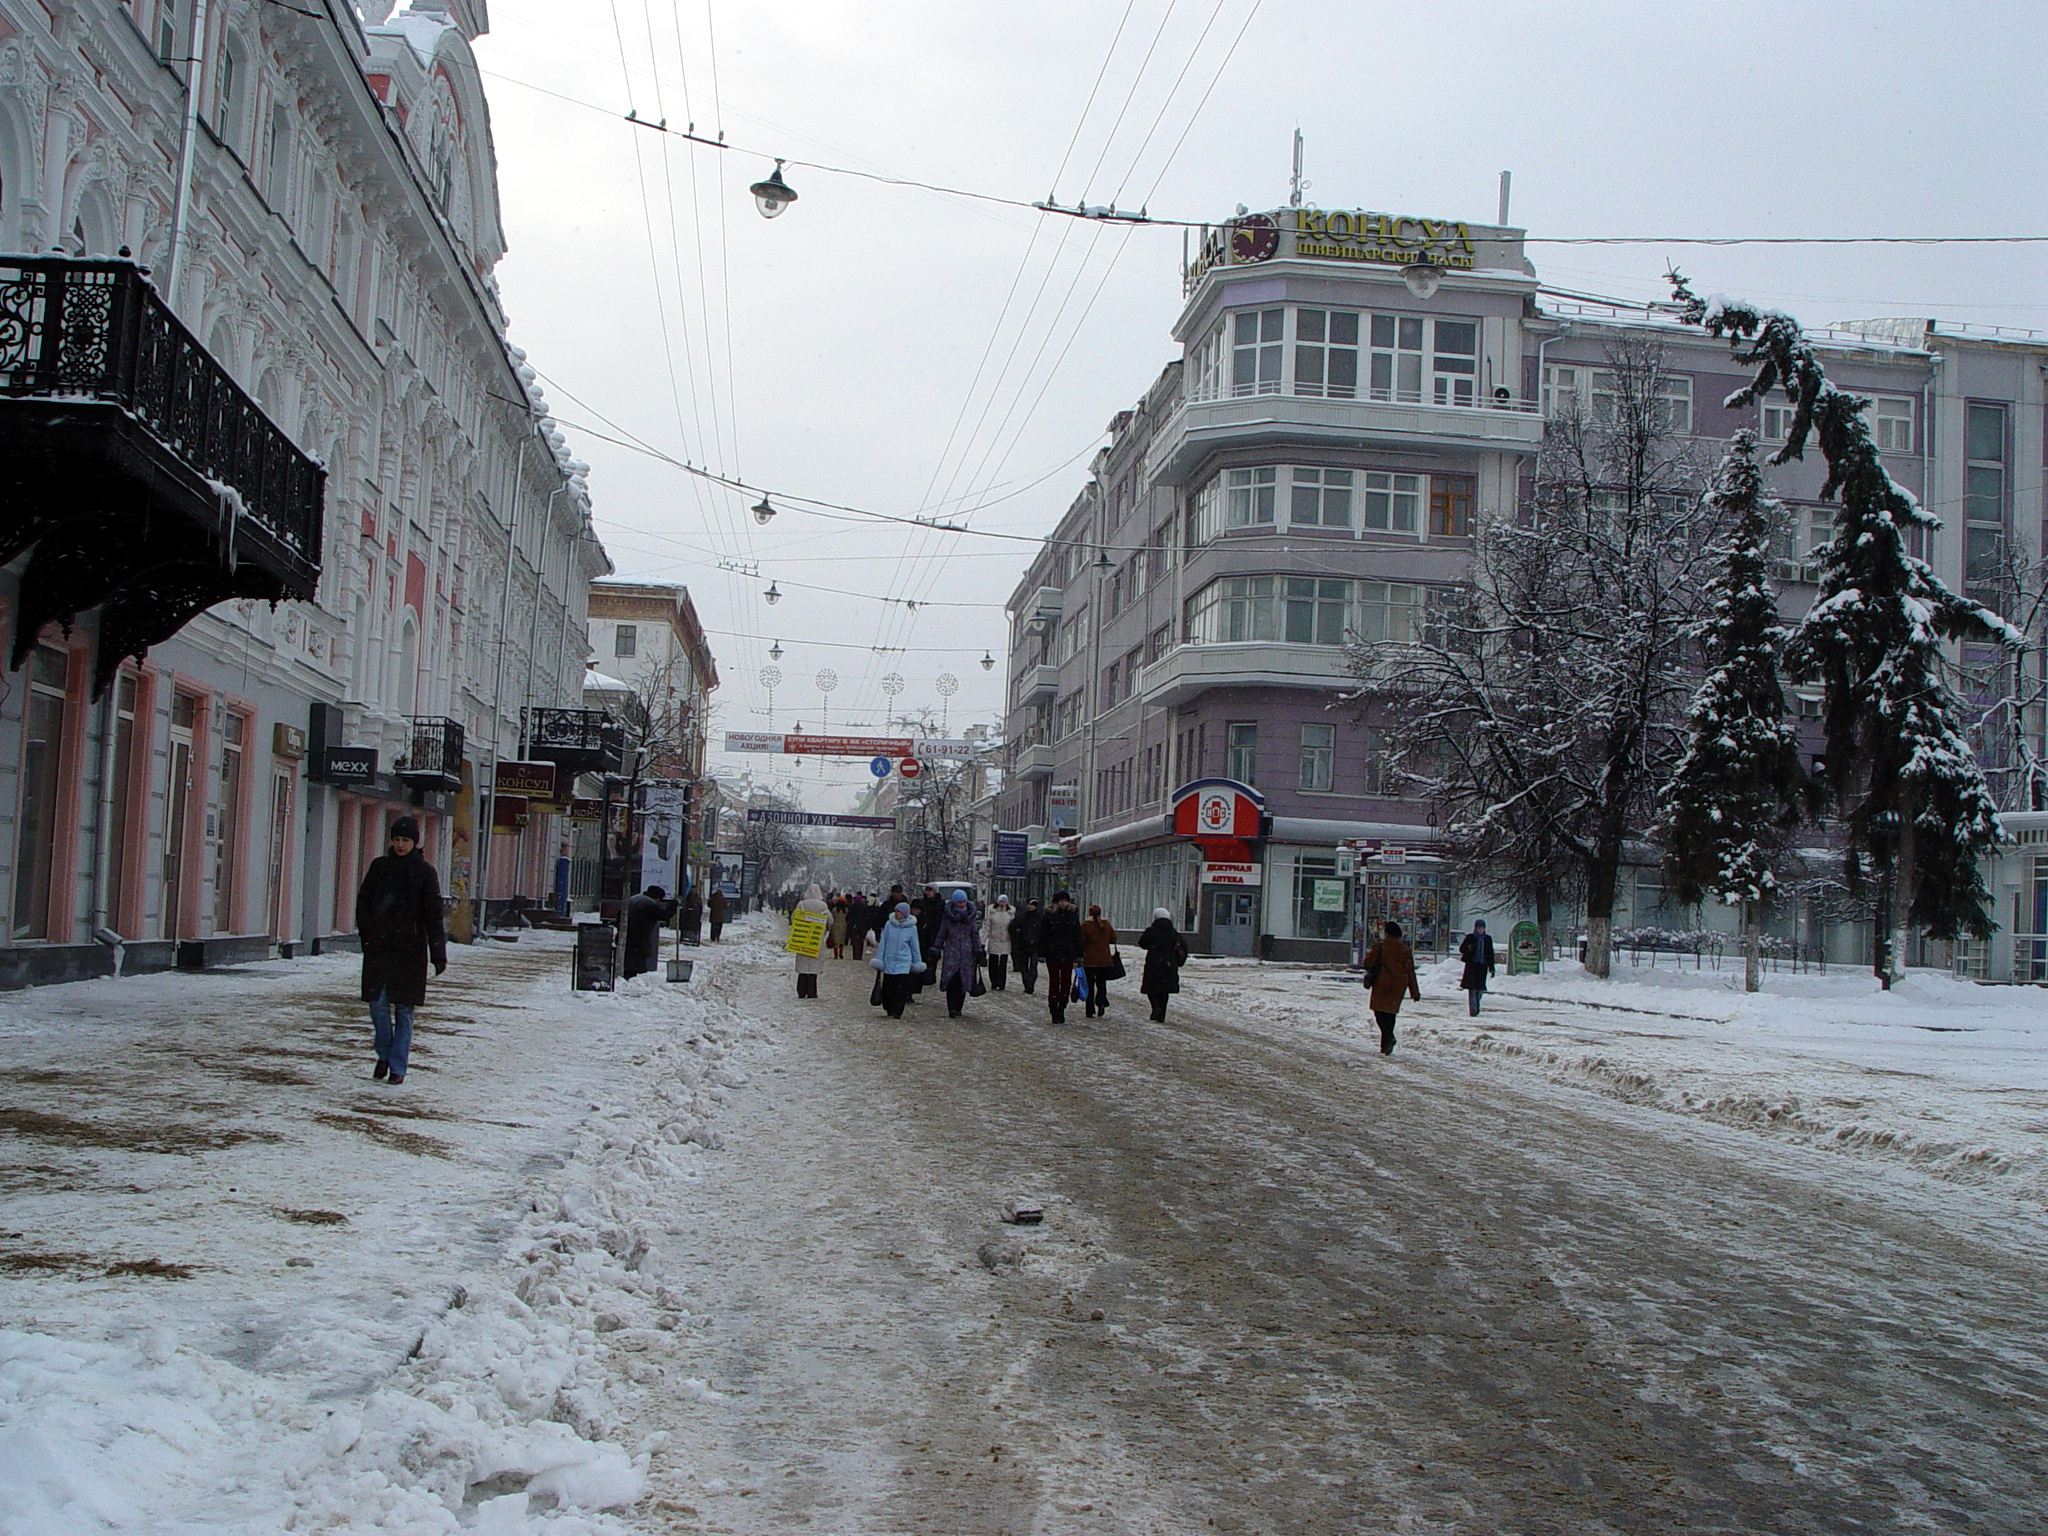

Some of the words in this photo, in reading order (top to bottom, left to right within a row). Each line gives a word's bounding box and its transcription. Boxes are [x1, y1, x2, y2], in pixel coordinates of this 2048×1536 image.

[1296, 209, 1475, 253] КОНСУЛ
[1296, 242, 1420, 264] ШВЕЙЦАРСКИ
[1426, 252, 1475, 268] ЧАСЫ
[728, 733, 782, 742] НОВОГОДНЯЯ
[740, 742, 769, 751] АКЦИЯ!
[925, 743, 970, 755] 61-91-22
[497, 776, 550, 790] КОНСУЛ
[811, 813, 838, 826] УДАР
[1207, 863, 1253, 872] ДЕЖУРНАЯ
[1211, 874, 1244, 883] АПТЕКА
